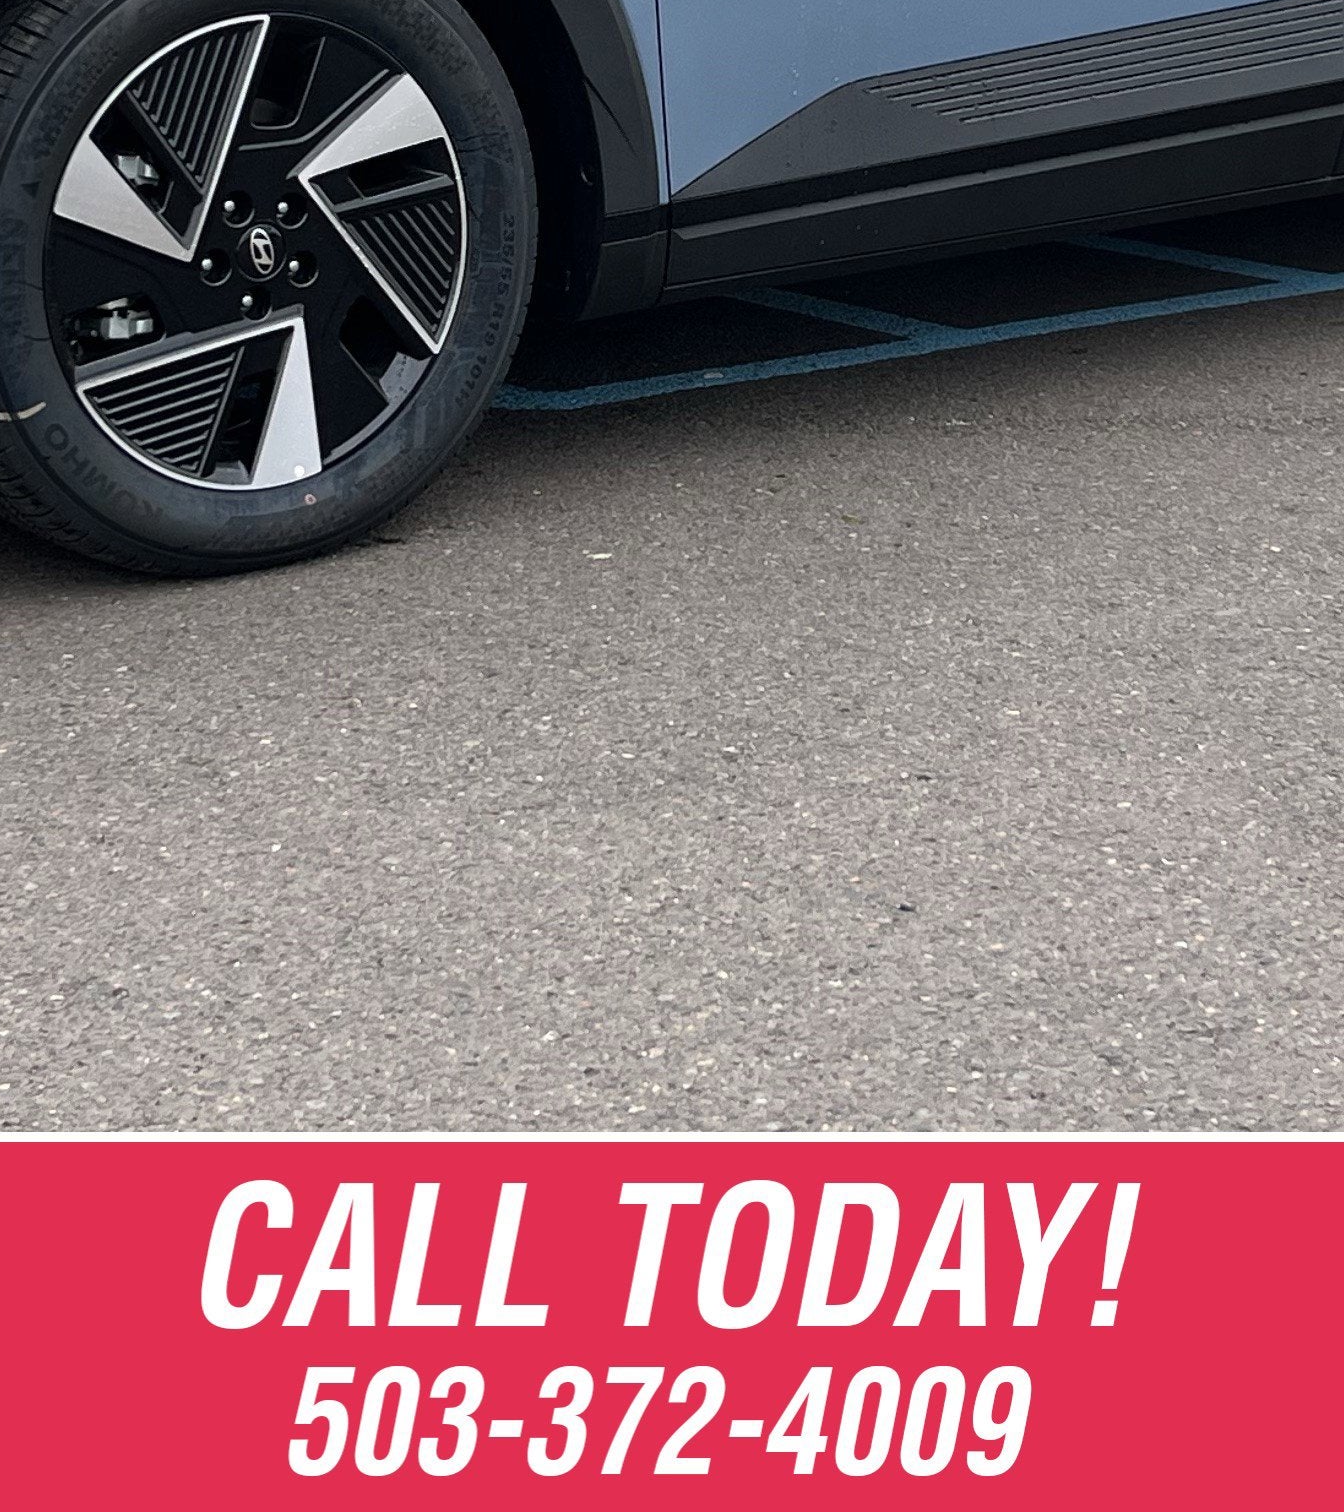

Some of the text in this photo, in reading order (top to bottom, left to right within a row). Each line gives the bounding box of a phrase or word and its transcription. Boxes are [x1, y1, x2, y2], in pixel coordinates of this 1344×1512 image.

[500, 212, 516, 297] 235/55
[484, 302, 506, 347] R19
[43, 423, 163, 522] KUMHO
